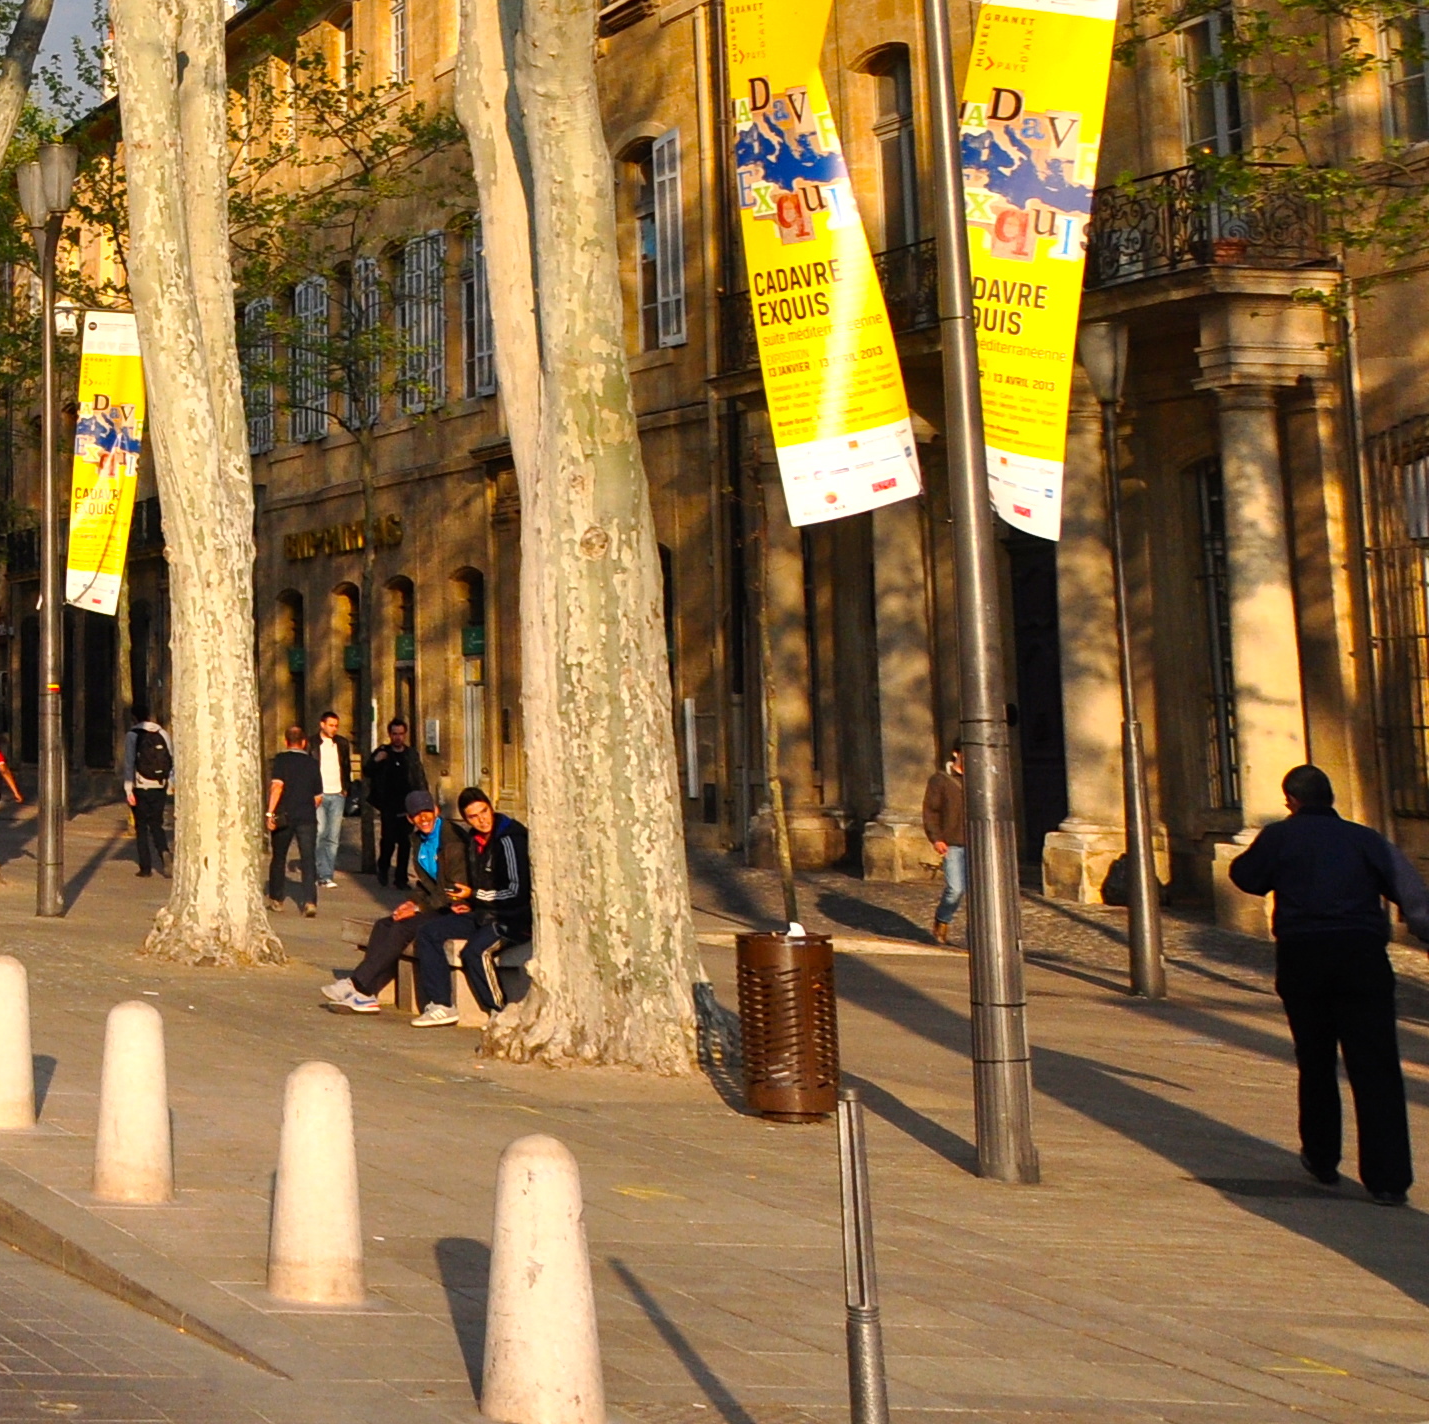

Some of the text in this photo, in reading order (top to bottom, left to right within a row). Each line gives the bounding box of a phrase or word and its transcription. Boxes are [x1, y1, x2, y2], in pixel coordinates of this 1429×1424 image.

[729, 2, 764, 15] GRANET
[984, 12, 1036, 27] GRANET
[996, 61, 1026, 73] PAYS
[753, 258, 844, 297] CADAVRE
[973, 275, 1048, 310] DAVRE
[757, 291, 830, 327] EXQUIS
[762, 329, 786, 348] suite
[765, 348, 810, 366] EXPOSITION
[768, 367, 777, 378] 13
[778, 361, 810, 376] JANVIER
[818, 357, 830, 368] 13
[860, 346, 884, 360] 2013
[993, 372, 1003, 384] 13
[1005, 375, 1029, 388] AVRIL
[1032, 379, 1055, 392] 2013
[75, 487, 121, 501] CADAVR
[74, 502, 116, 516] EQUIS
